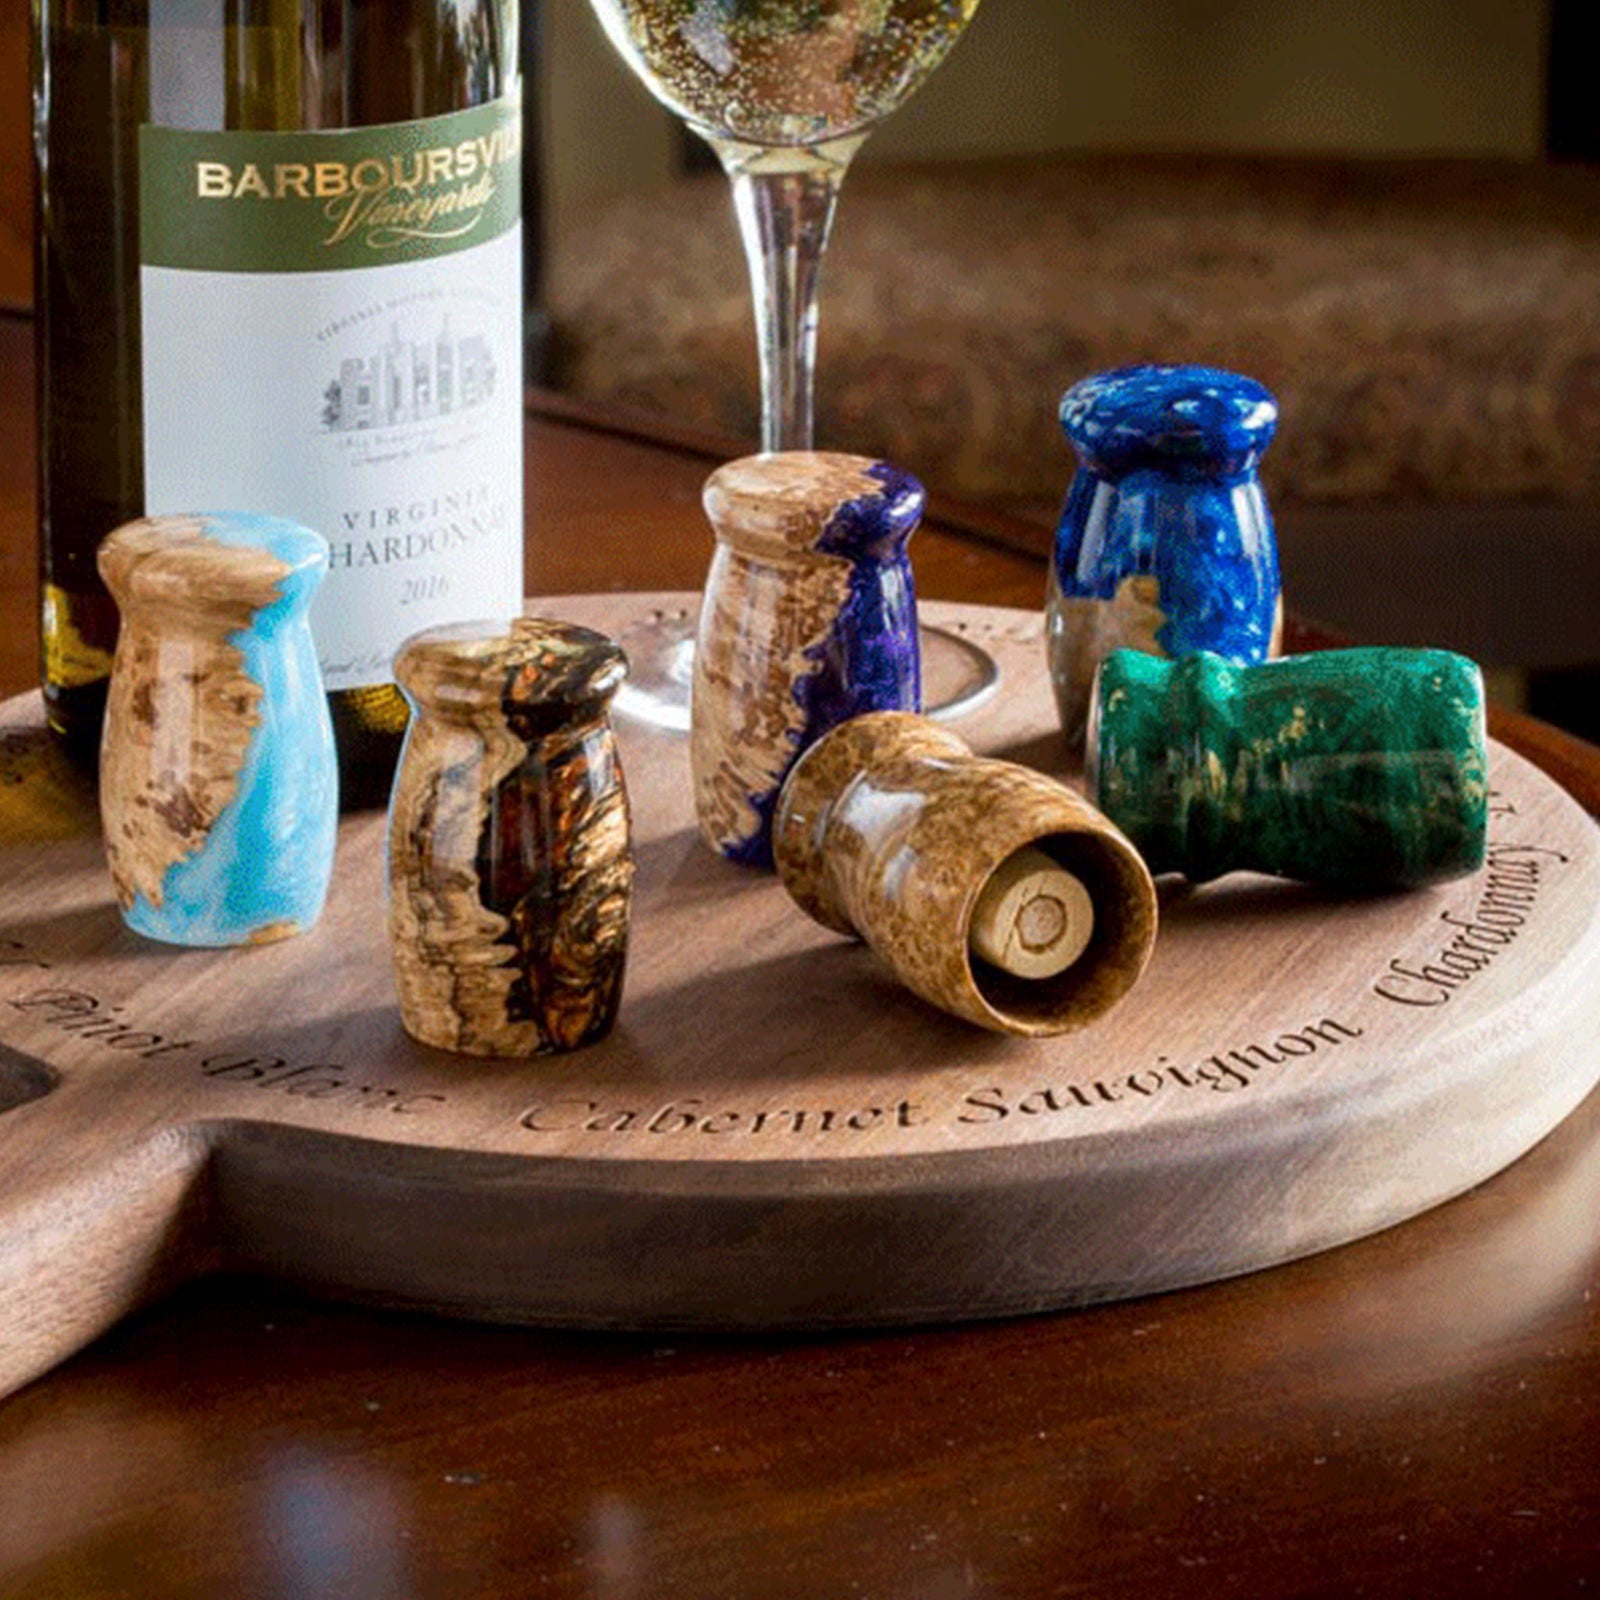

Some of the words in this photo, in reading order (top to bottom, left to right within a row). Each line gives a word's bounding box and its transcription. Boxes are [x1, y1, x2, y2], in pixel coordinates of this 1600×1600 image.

[400, 575, 450, 605] 2016
[6, 988, 197, 1057] Pinot
[519, 1098, 923, 1134] Cabernet
[957, 1017, 1363, 1124] Sauvignon
